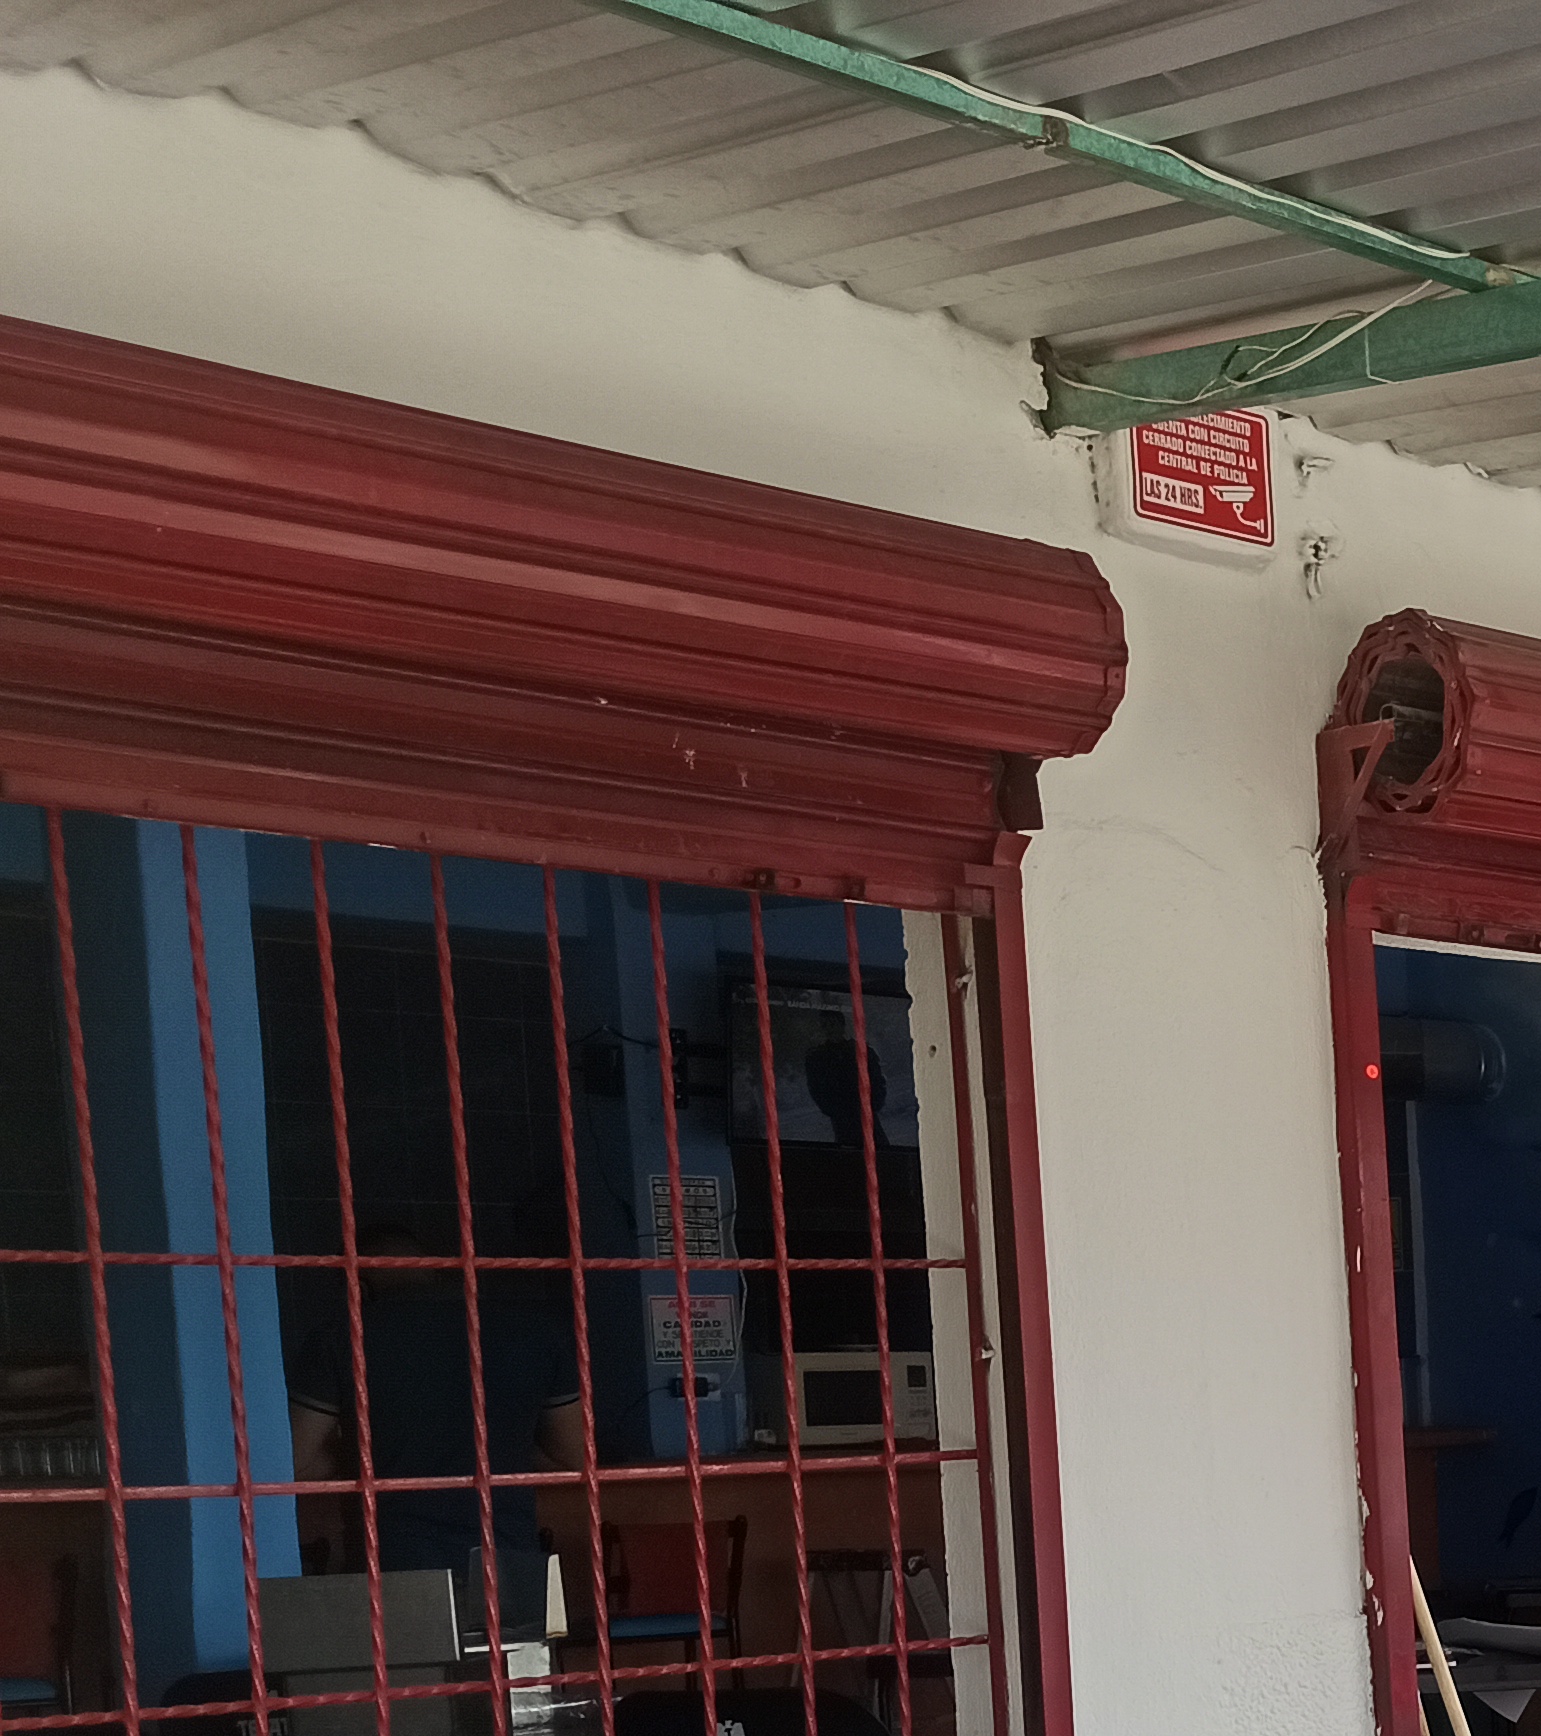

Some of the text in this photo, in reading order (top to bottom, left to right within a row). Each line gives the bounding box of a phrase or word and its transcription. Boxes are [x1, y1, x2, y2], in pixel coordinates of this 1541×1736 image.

[1189, 424, 1209, 442] CON
[1210, 430, 1249, 452] CIRCUITO
[1190, 413, 1251, 437] LECIMIENTO
[1143, 430, 1258, 471] CERRADO CONECTADO A LA
[1159, 451, 1248, 484] CENTRAL DE POLICIA
[1144, 476, 1203, 509] LAS 24 HRS.
[663, 1320, 721, 1329] CAIDAD
[656, 1350, 733, 1359] AMAILIDAD
